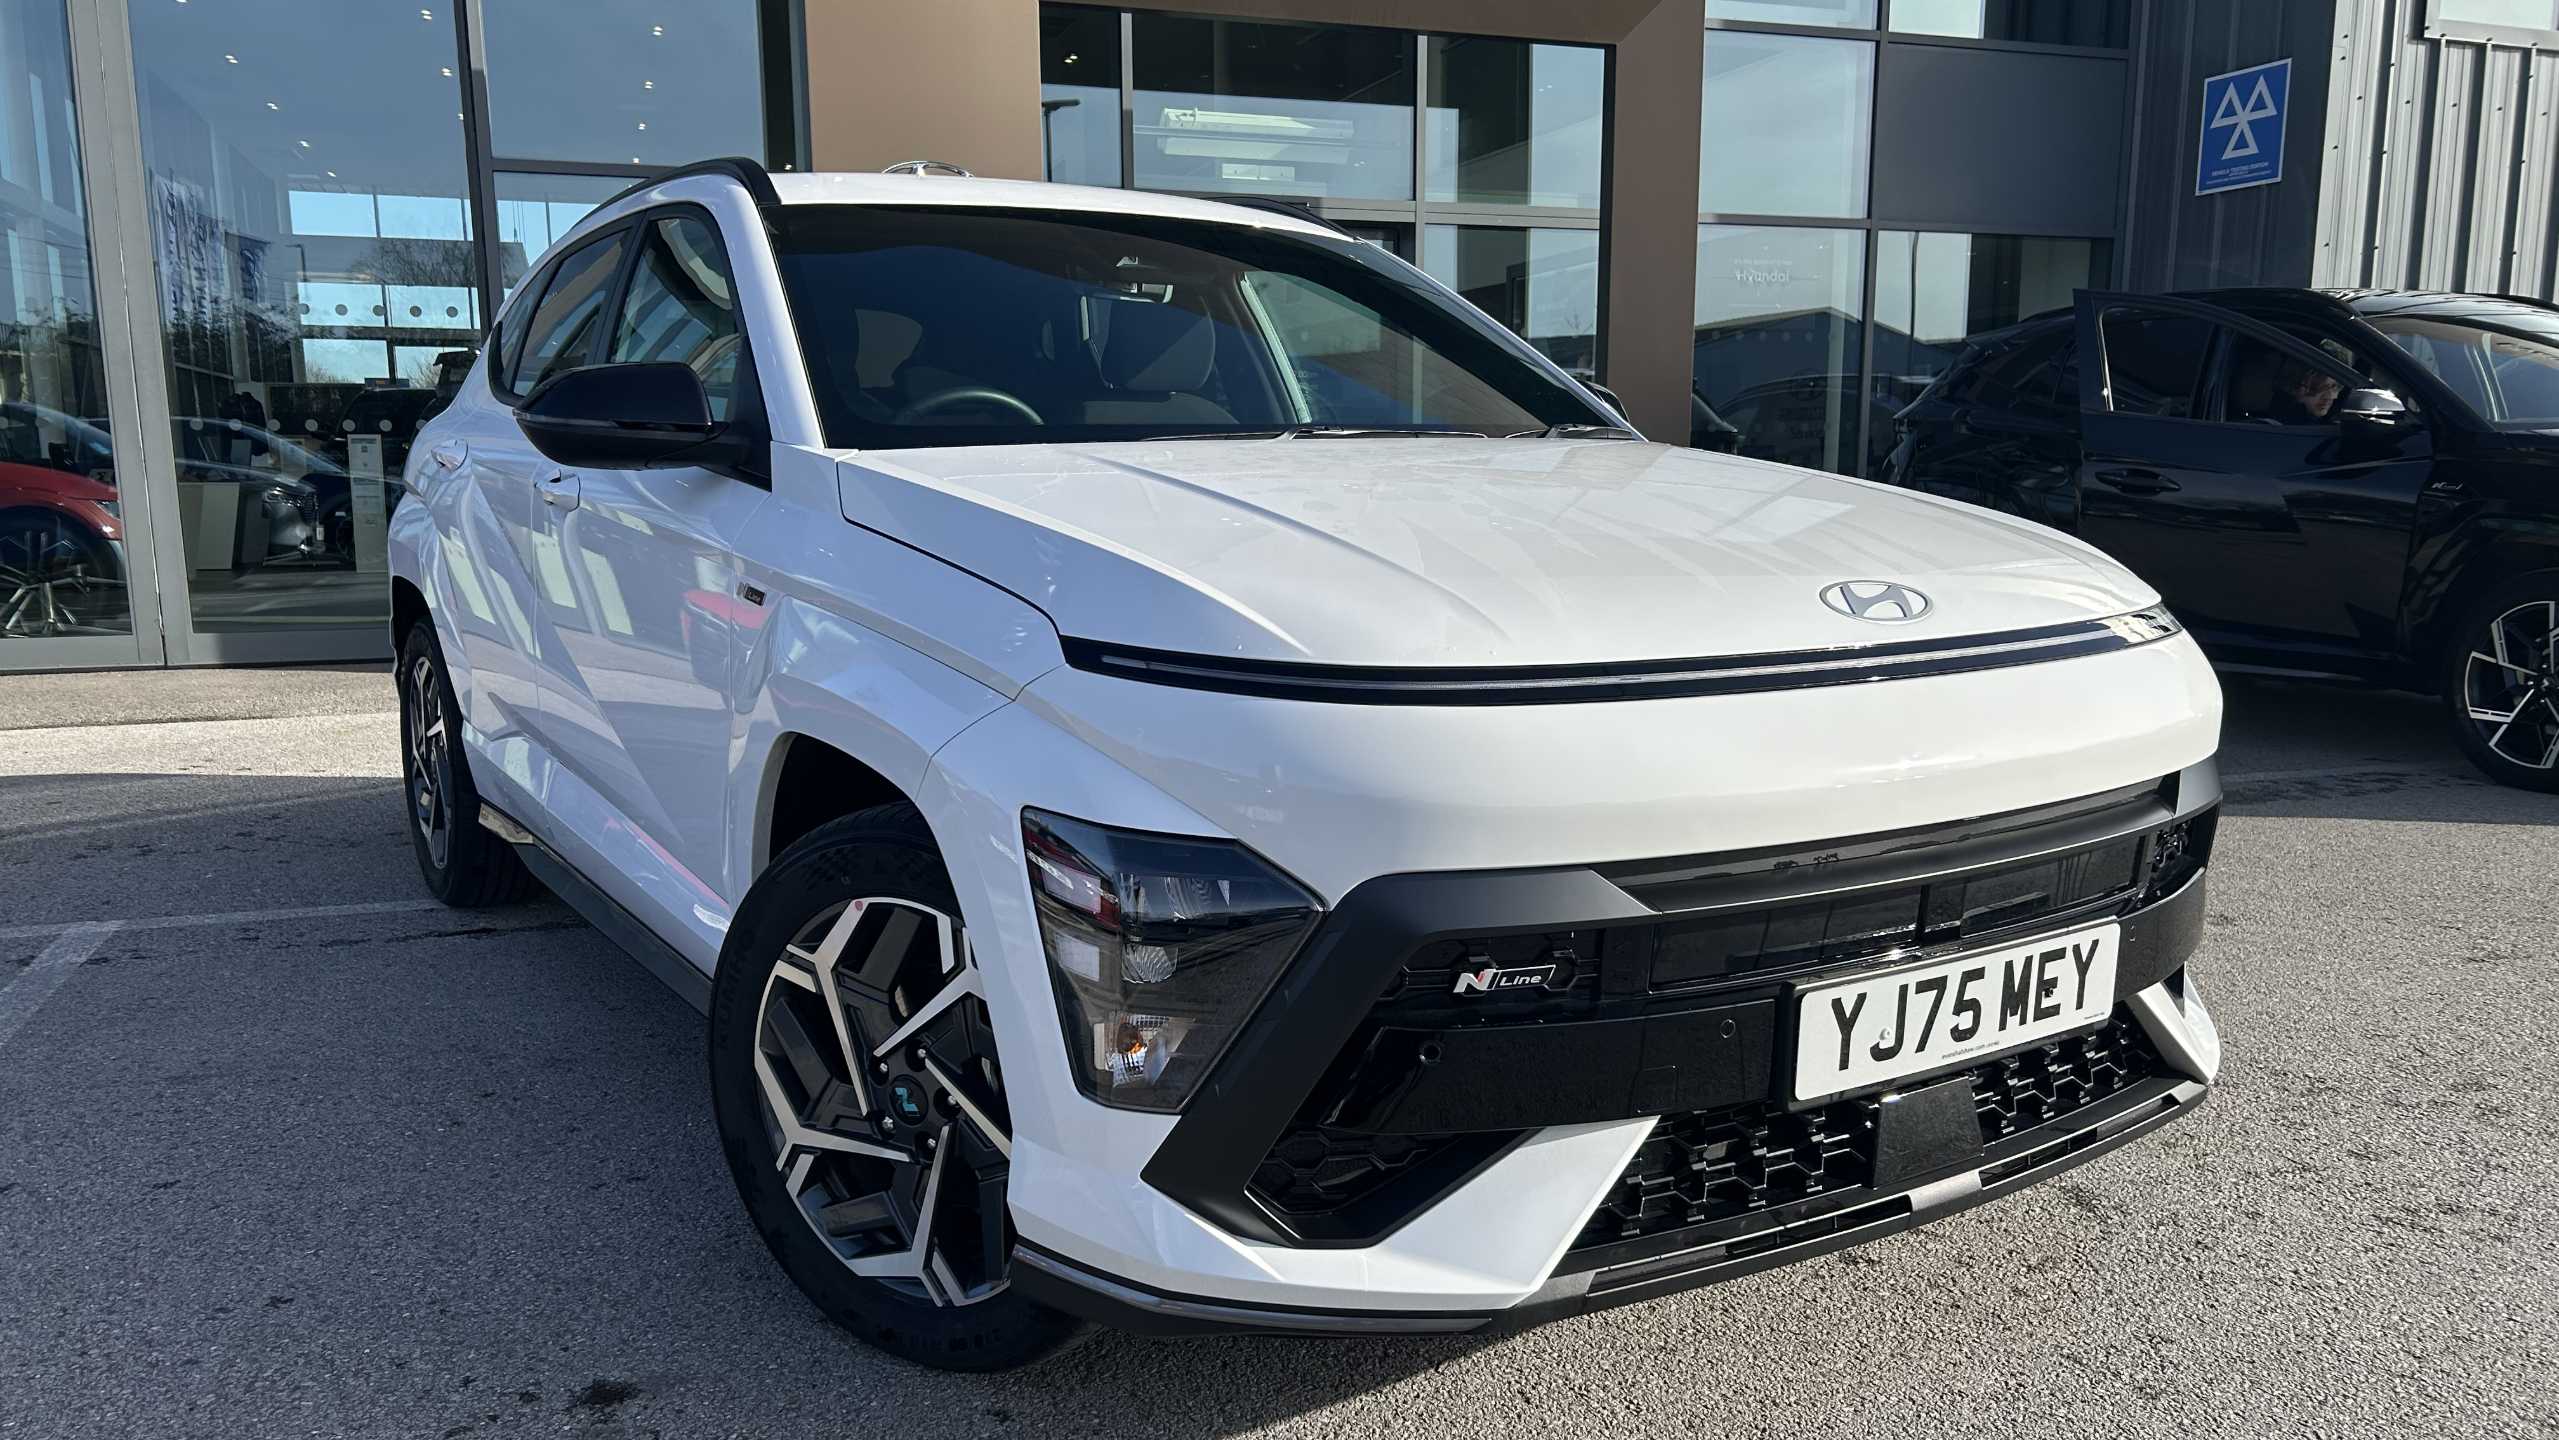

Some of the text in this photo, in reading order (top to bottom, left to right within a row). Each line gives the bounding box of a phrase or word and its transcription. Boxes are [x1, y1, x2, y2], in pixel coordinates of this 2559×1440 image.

[1735, 269, 1790, 283] Hyundai
[1453, 968, 1542, 993] N Line
[1831, 939, 2099, 1071] YJ75 MEY
